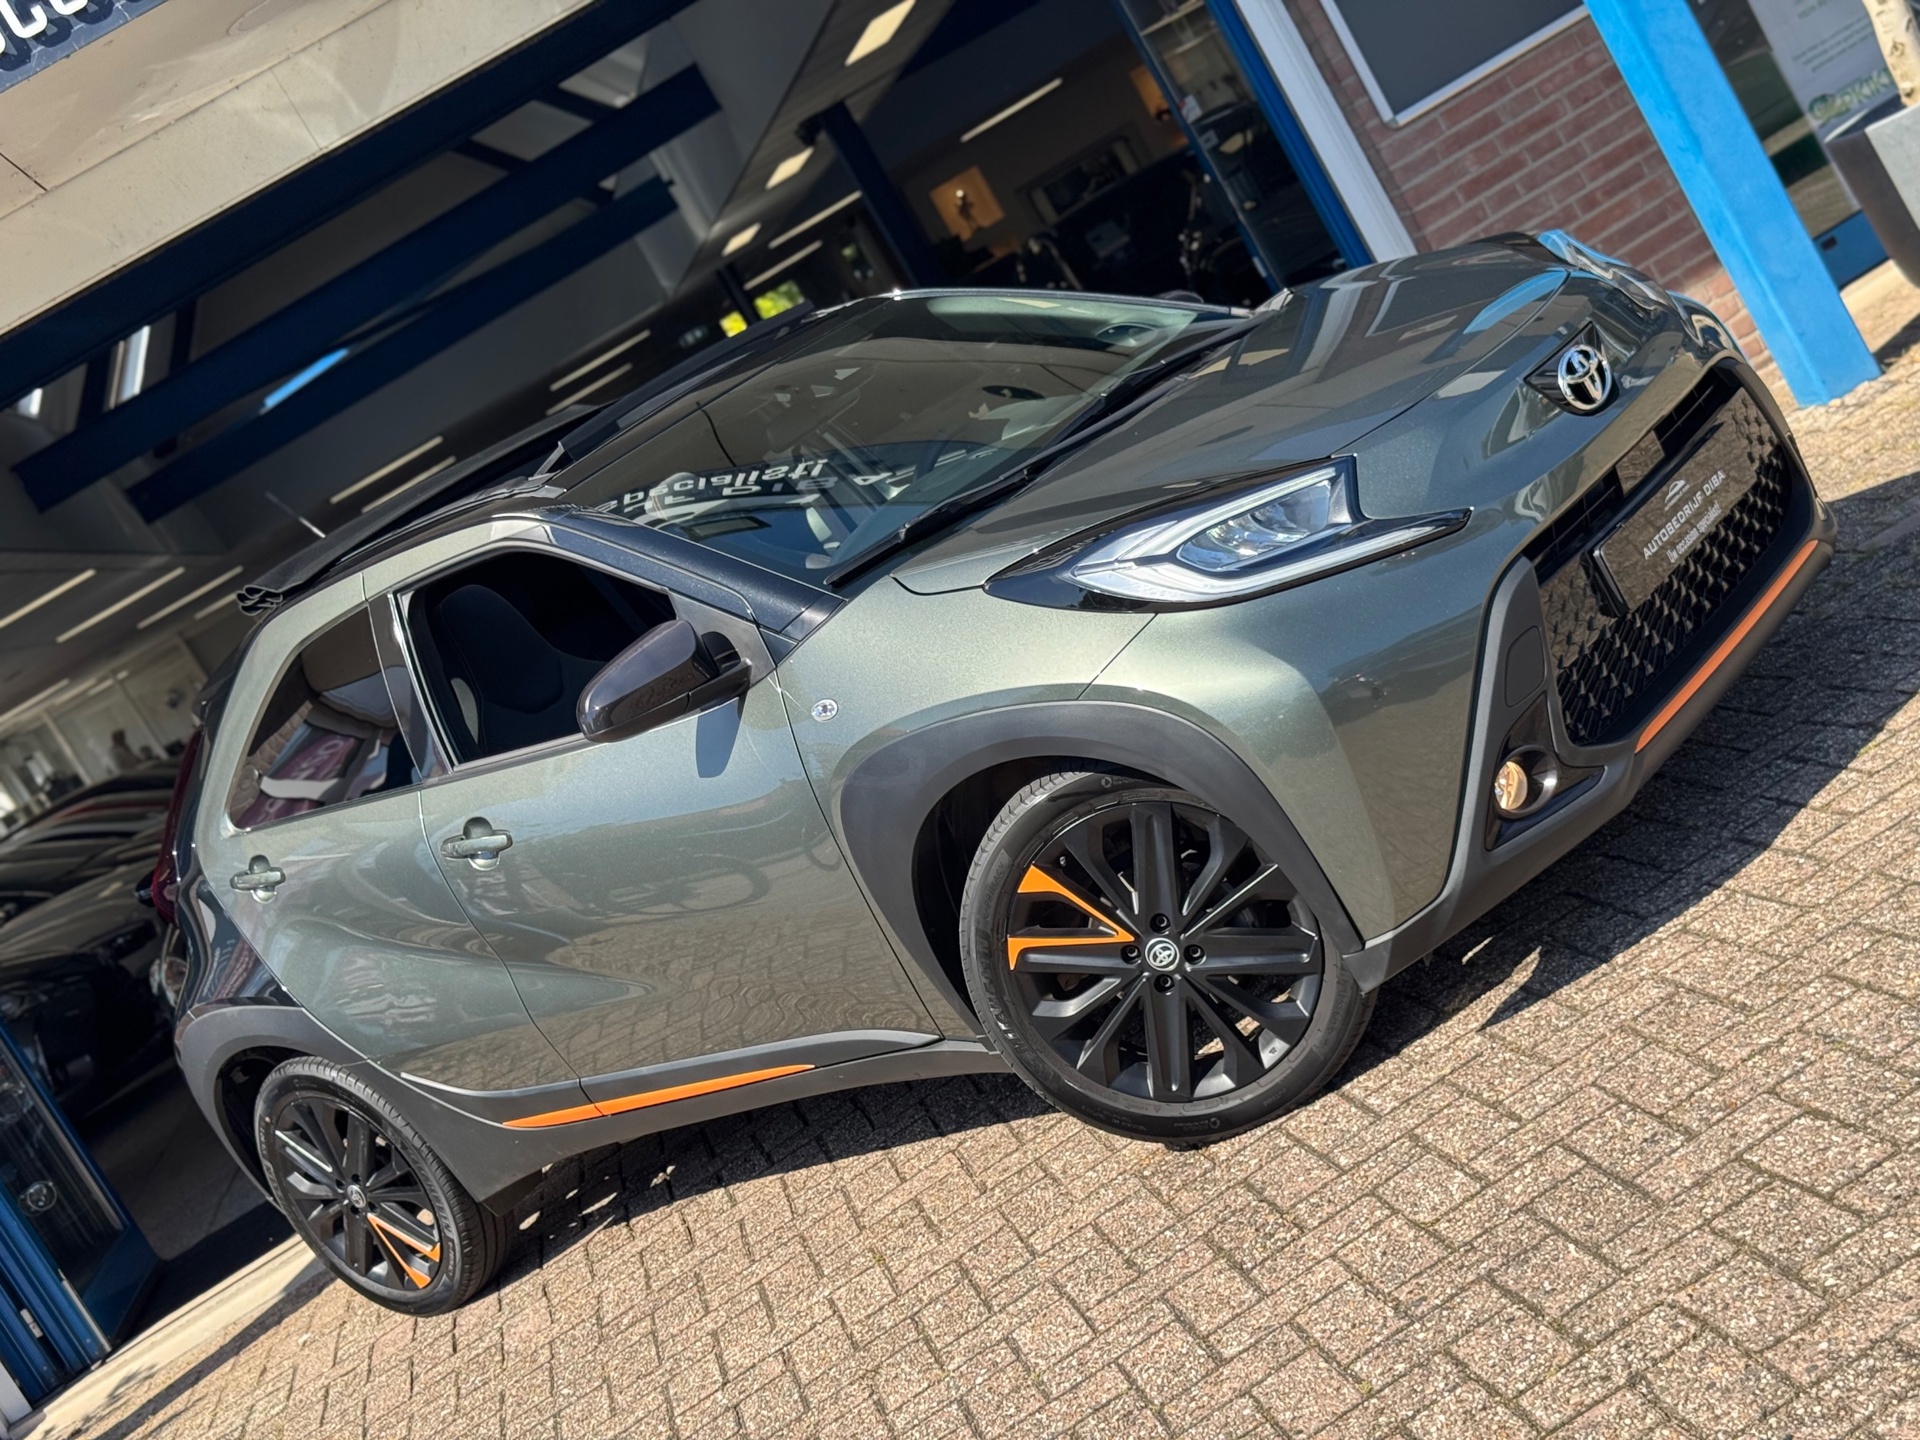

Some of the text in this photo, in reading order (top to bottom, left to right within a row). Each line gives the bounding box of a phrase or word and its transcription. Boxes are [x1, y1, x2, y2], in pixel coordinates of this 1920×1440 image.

[1643, 490, 1705, 560] AUTOBEDRIJF
[1702, 470, 1726, 496] DIBA
[1666, 549, 1678, 563] Uw
[1676, 527, 1699, 555] occasion
